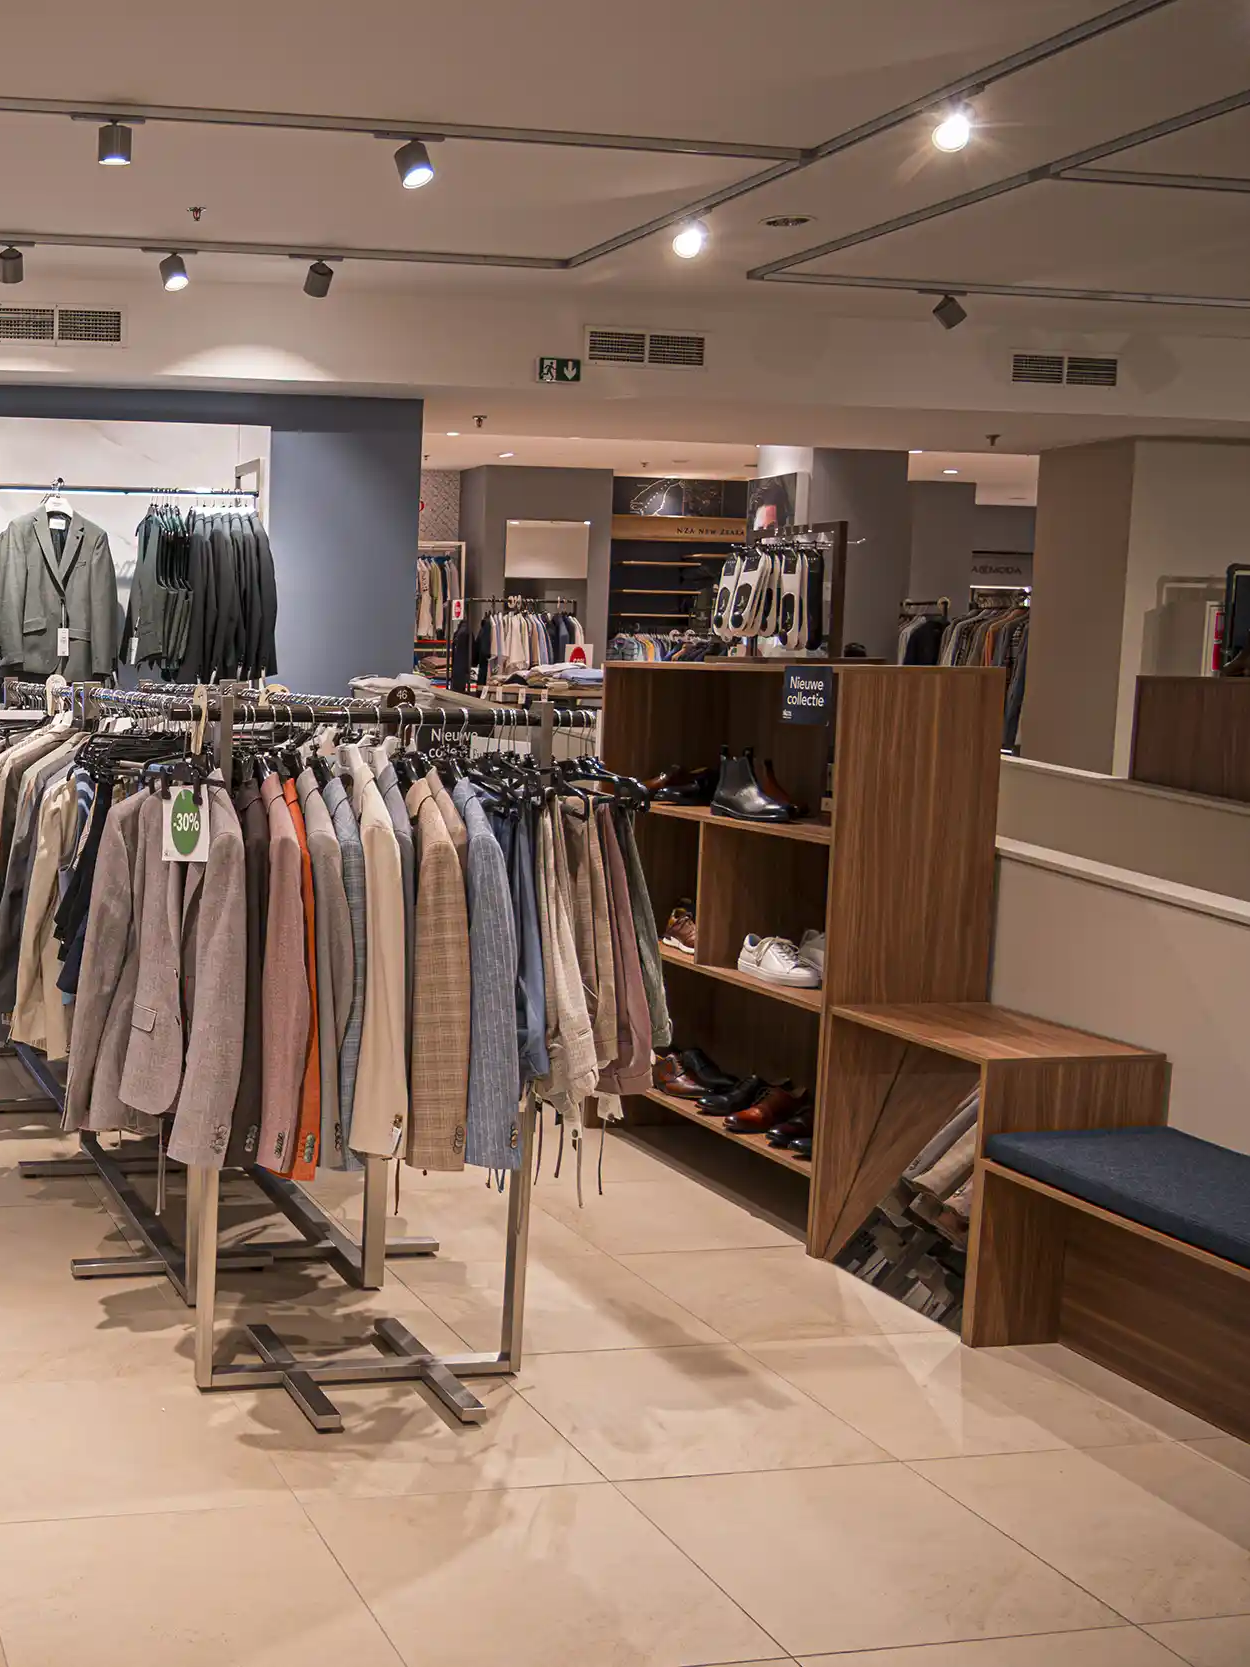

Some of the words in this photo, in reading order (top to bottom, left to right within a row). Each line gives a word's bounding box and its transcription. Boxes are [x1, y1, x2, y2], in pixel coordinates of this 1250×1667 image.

[676, 527, 695, 535] NZA
[719, 528, 746, 536] ZEALA
[789, 676, 824, 691] Nieuwe
[396, 689, 408, 700] 46
[786, 691, 825, 707] collectie
[173, 812, 200, 832] -30%
